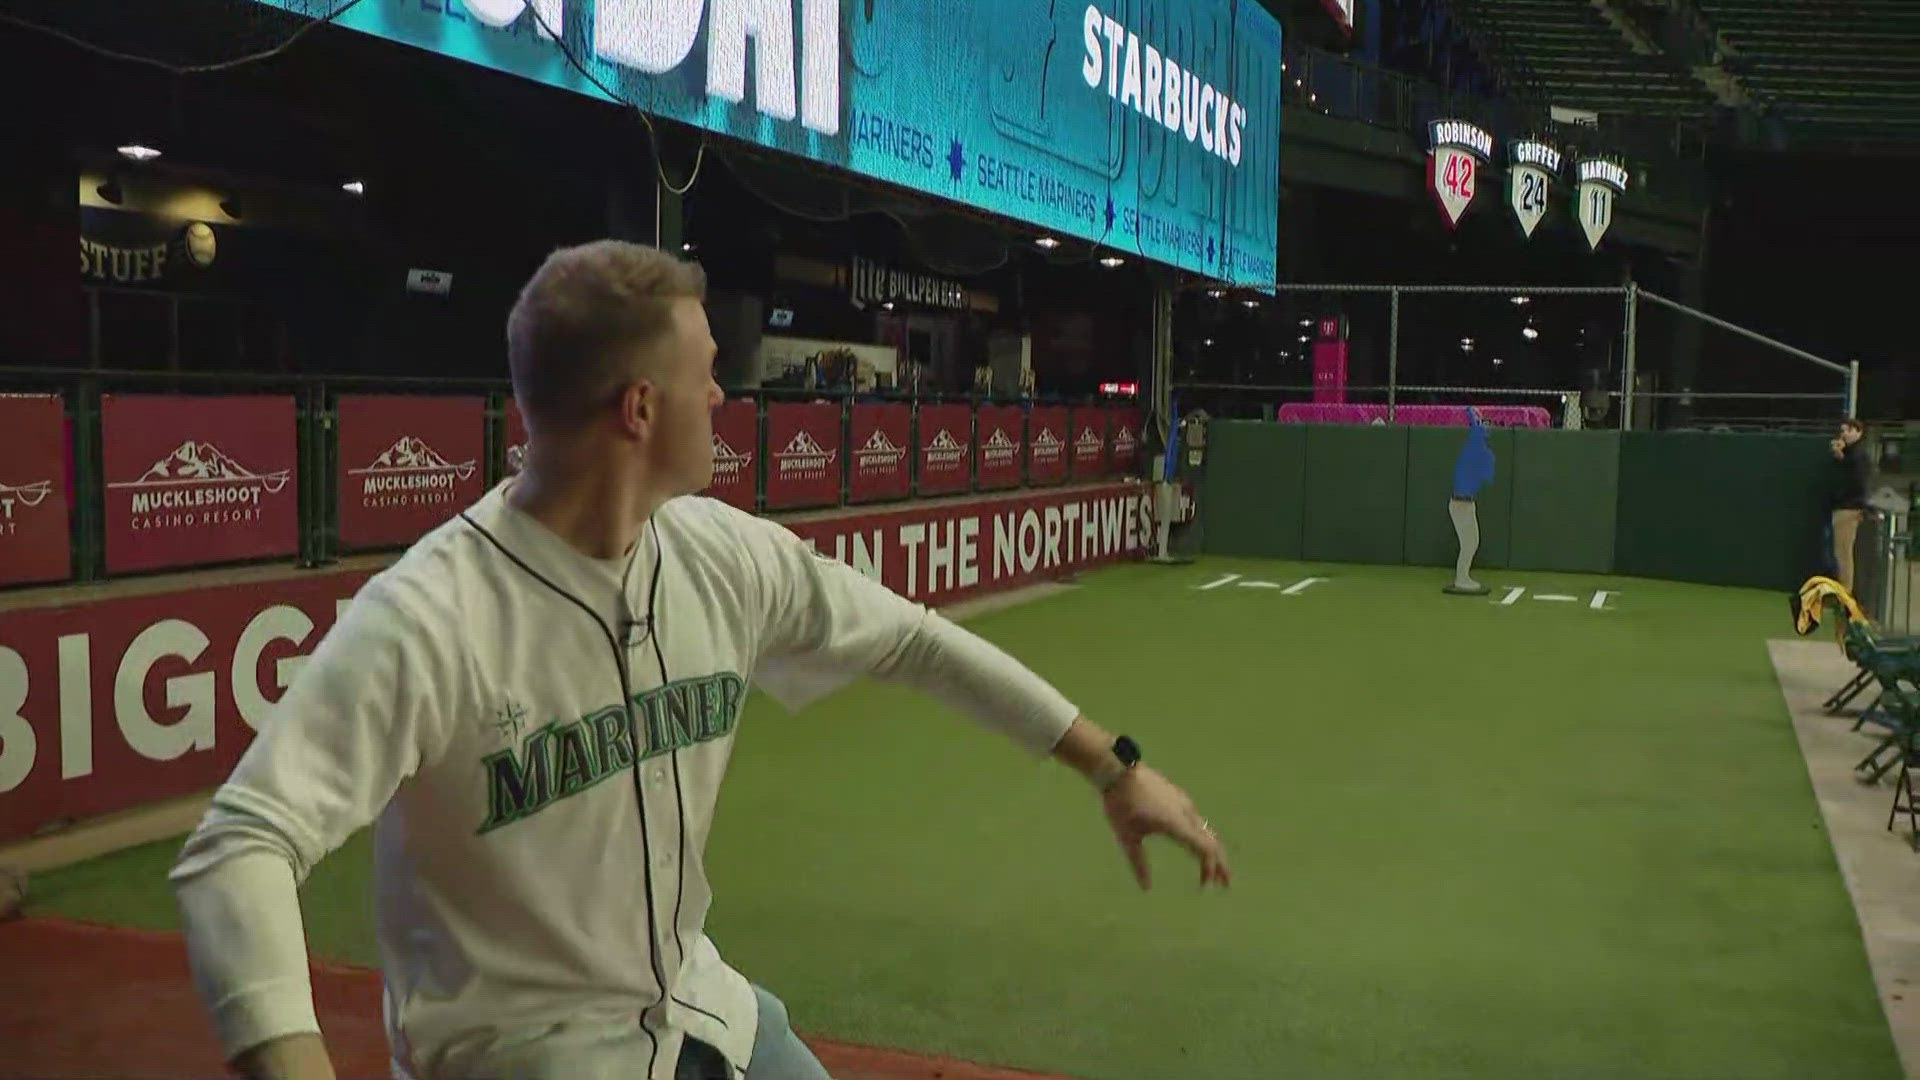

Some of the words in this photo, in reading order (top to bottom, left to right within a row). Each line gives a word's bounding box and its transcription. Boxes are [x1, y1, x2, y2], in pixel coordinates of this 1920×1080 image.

[1436, 121, 1493, 158] ROBINSON
[1517, 142, 1561, 172] GRIFFEY
[978, 153, 1034, 202] SEATTLE
[1038, 174, 1096, 223] MARINERS
[1443, 153, 1473, 199] 42
[1521, 171, 1545, 213] 24
[1581, 160, 1629, 191] MARTINEZ
[1123, 206, 1160, 245] SETTLE
[1590, 188, 1606, 226] 11
[80, 236, 167, 282] STUFF
[889, 269, 939, 305] BULLPEN
[941, 280, 962, 308] BAR
[131, 486, 261, 514] MUCKLESHOOT
[363, 473, 455, 495] MUCKLESHOOT
[363, 495, 407, 507] CASINO
[414, 492, 455, 504] RESORT
[131, 514, 194, 530] CASINO
[203, 508, 260, 524] RESORT
[900, 516, 979, 598] THE
[993, 494, 1162, 580] NORTHWES
[0, 600, 350, 793] IGG
